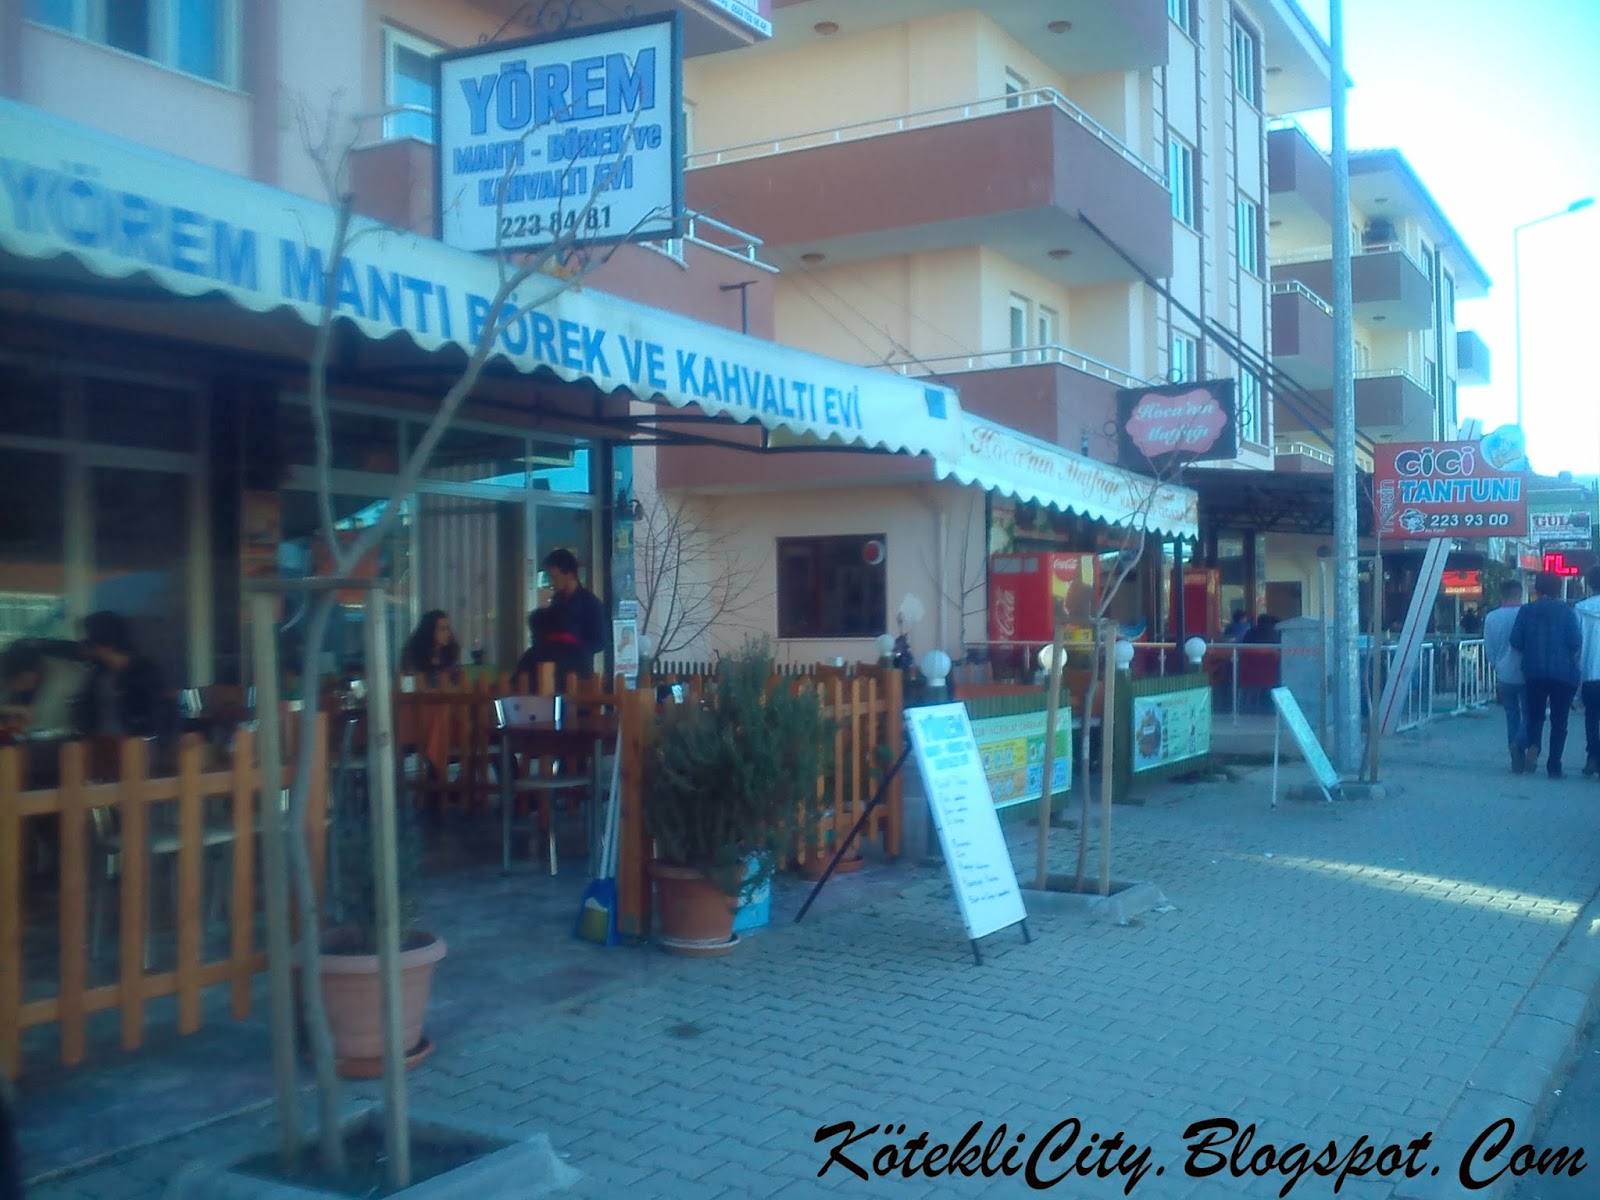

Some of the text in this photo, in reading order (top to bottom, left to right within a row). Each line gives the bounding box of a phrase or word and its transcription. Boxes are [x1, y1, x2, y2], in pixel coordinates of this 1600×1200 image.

[459, 47, 656, 135] YÖREM
[453, 140, 525, 174] MANTI
[548, 125, 627, 164] BÖREK
[633, 124, 661, 150] ve
[479, 166, 588, 206] KAHVALTI
[501, 214, 541, 238] 223
[586, 205, 611, 230] 81
[0, 159, 260, 292] YÖREM
[279, 238, 451, 339] MANTI
[465, 292, 611, 378] BÖREK
[619, 335, 667, 390] VE
[676, 349, 817, 423] KAHVALTI
[1430, 513, 1509, 527] 223 93 00
